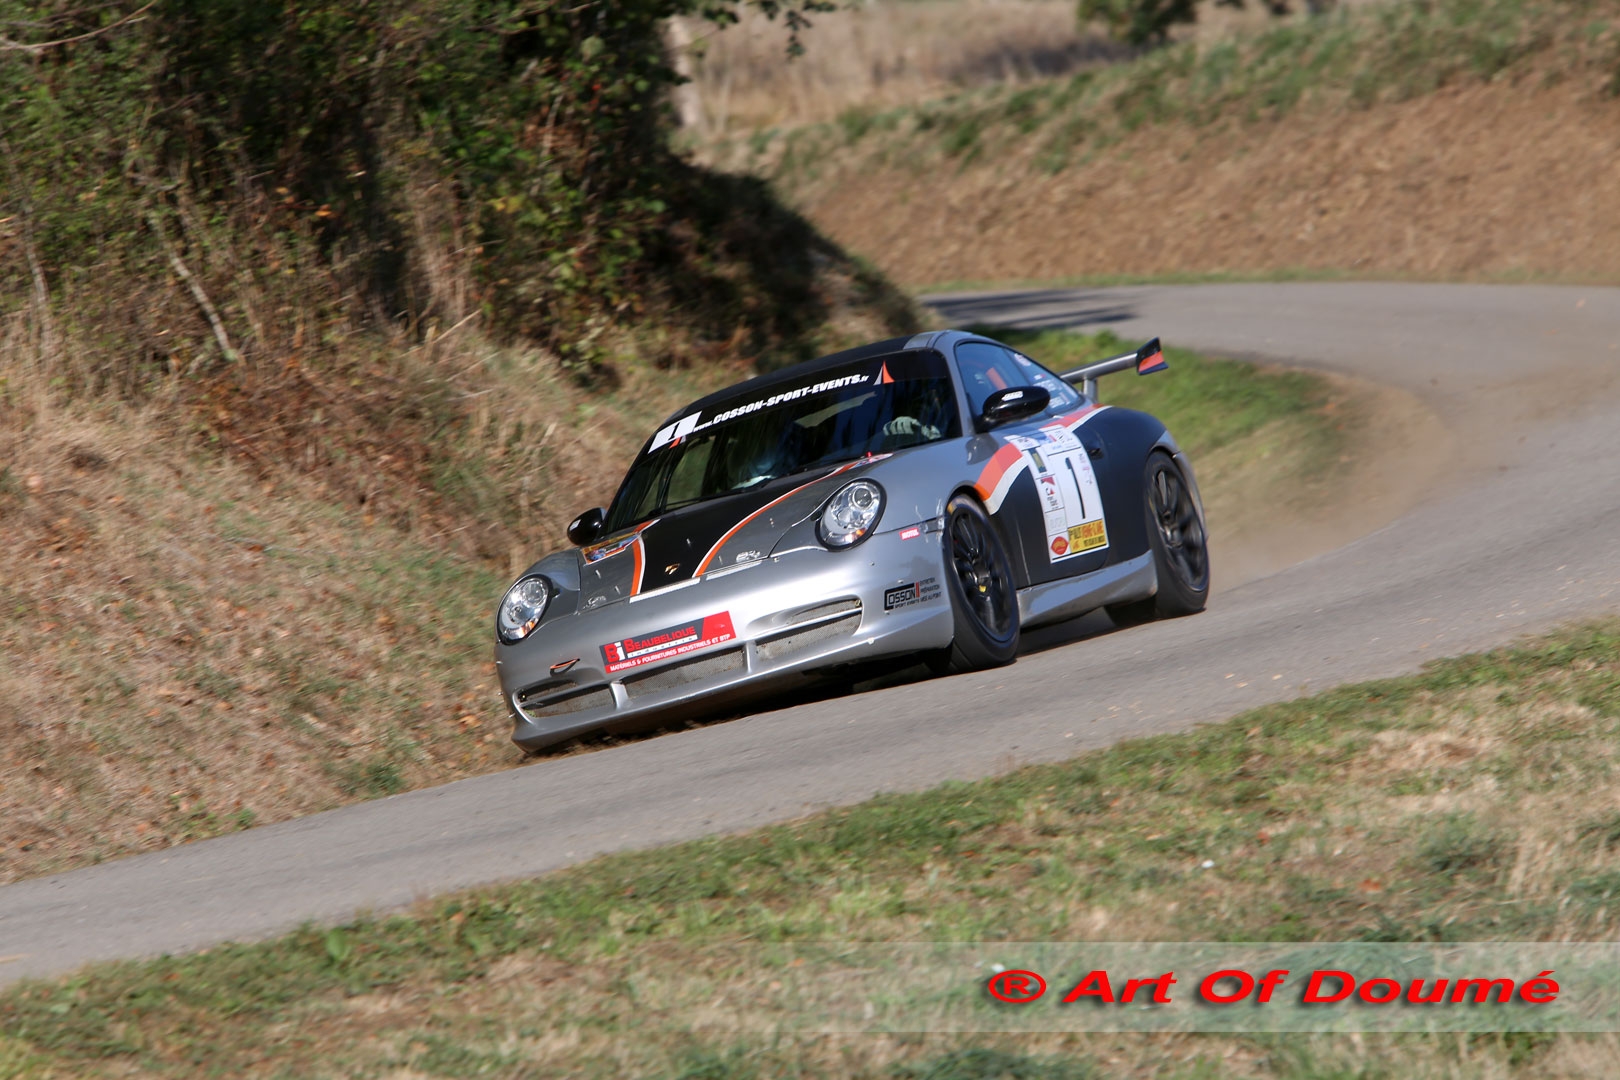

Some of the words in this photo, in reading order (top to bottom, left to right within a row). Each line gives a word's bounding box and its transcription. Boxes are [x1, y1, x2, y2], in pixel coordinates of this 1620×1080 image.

[1065, 457, 1086, 519] 1
[623, 626, 696, 652] BEAUBELIQUE
[642, 649, 677, 663] FOURNITURES
[678, 640, 711, 654] INDUSTRIELS
[712, 637, 719, 645] ET
[720, 633, 731, 643] BTP
